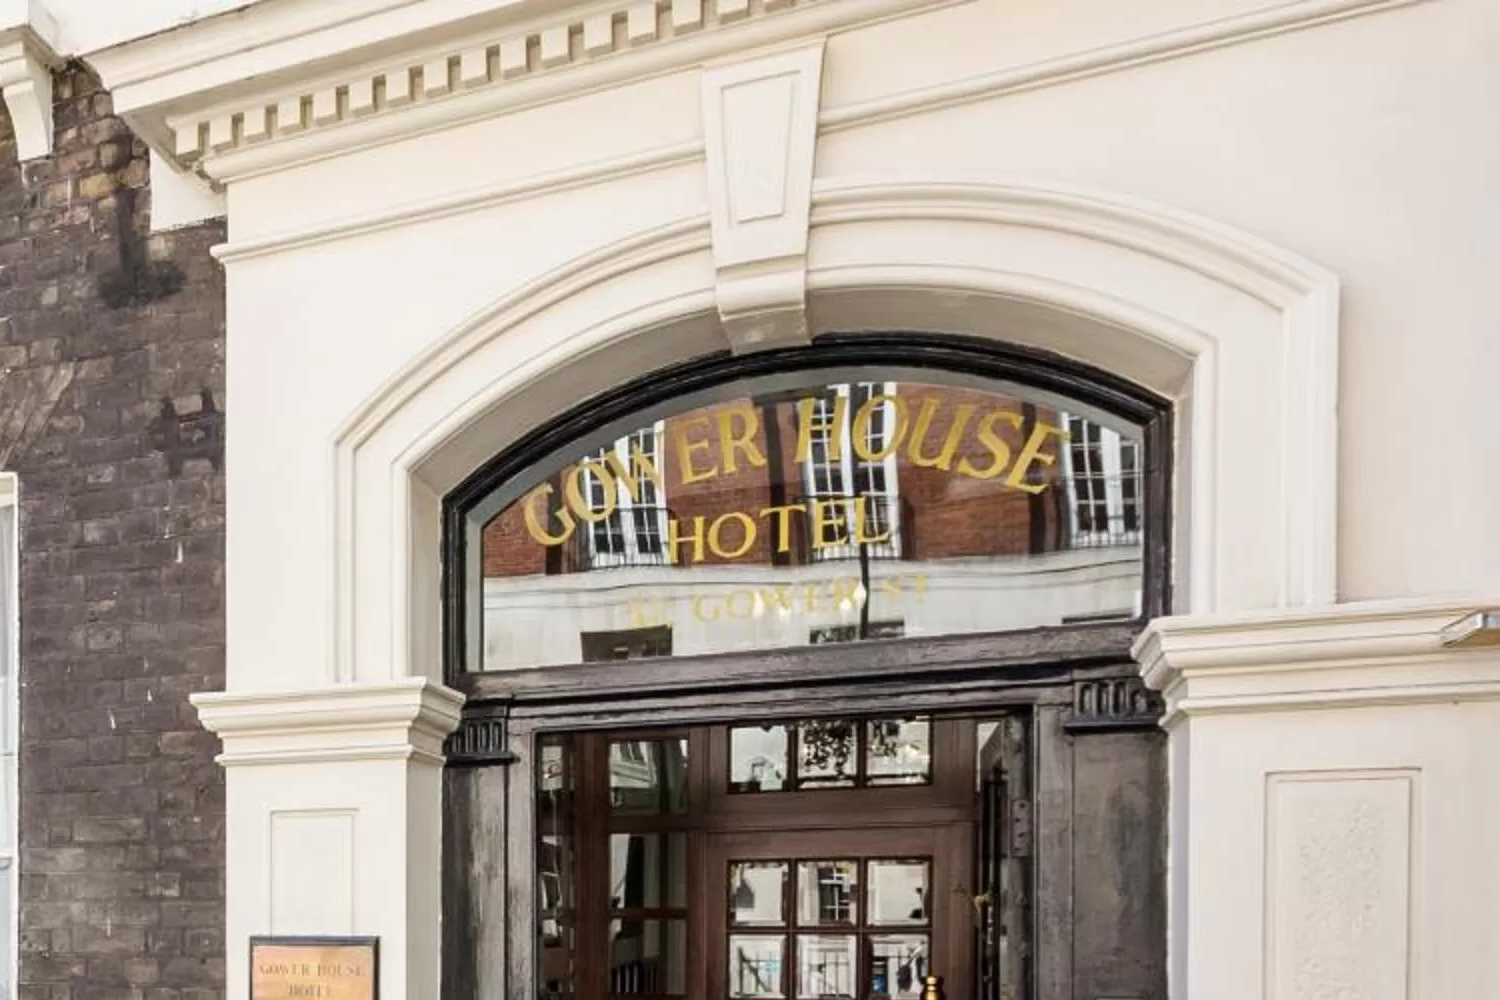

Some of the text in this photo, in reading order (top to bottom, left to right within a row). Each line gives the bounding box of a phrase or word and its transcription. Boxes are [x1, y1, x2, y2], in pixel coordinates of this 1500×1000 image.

[523, 394, 1071, 546] GOWER HOUSE
[667, 496, 890, 563] HOTEL
